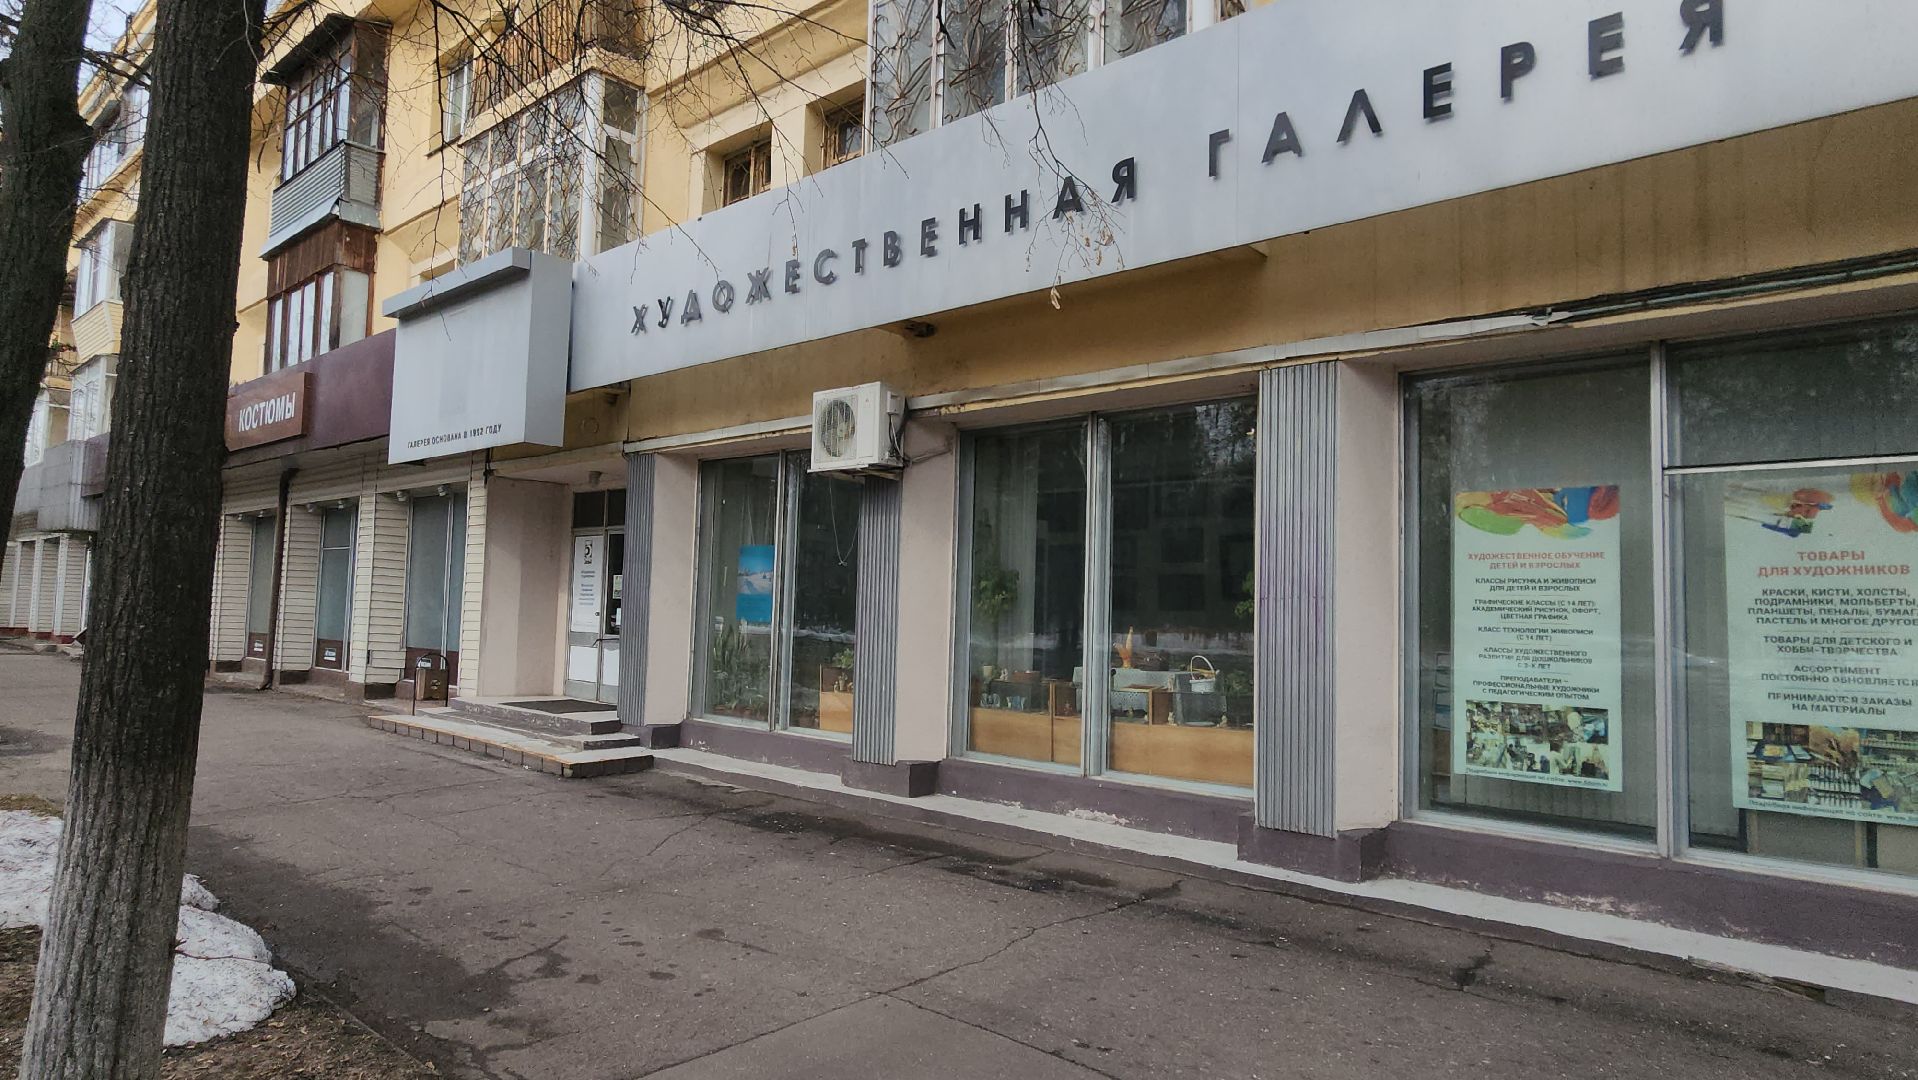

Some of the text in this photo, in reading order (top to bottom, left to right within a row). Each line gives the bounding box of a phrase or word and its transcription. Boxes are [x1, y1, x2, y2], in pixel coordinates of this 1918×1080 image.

[631, 0, 1725, 335] ХУДОЖЕСТВЕННАЯ ГАЛЕРЕЯ
[238, 392, 296, 433] КОСТЮМЫ
[407, 438, 431, 449] ГАЛЕРЕЯ
[431, 432, 462, 445] ОСНОВАНА
[463, 430, 468, 439] В
[485, 423, 502, 434] ГОДУ
[1468, 552, 1553, 560] ХУДОЖЕСТВЕННОЕ
[1797, 551, 1865, 561] ТОВАРЫ
[1757, 565, 1911, 578] ДЛЯ ХУДОЖНИКОВ
[1762, 588, 1910, 597] КРАСКИ, КИСТИ, ХОЛСТЫ,
[1755, 598, 1836, 606] ПОДРАМНИКИ,
[1748, 608, 1918, 617] ПЛАНШЕТЫ, ПЕНАЛЫ, БУМАГ
[1756, 617, 1807, 625] ПАСТЕЛЬ
[1764, 636, 1810, 644] ТОВАРЫ
[1812, 637, 1836, 645] ДЛЯ
[1839, 637, 1901, 646] ДЕТСКОГО
[1515, 648, 1587, 657] ХУДОЖЕСТВЕННОГО
[1777, 645, 1898, 656] ХОББИ-ТВОРЧЕСТВА
[1531, 656, 1593, 664] ДОШКОЛЬНИКОВ
[1794, 665, 1881, 675] АССОРТИМЕНТ
[1500, 675, 1562, 684] ПРЕПОДАВАТЕЛИ
[1761, 673, 1829, 683] ПОСТОЯННО
[1473, 680, 1600, 693] ПРОФЕССИОНАЛЬНЫЕ ХУДОЖНИКИ
[1489, 688, 1555, 698] ПЕДАГОГИЧЕСКИМ
[1556, 692, 1589, 700] ОПЫТОМ
[1768, 693, 1912, 706] ПРИНИМАЮТСЯ ЗАКАЗЫ
[1792, 703, 1886, 715] НА МАТЕРИАЛЫ
